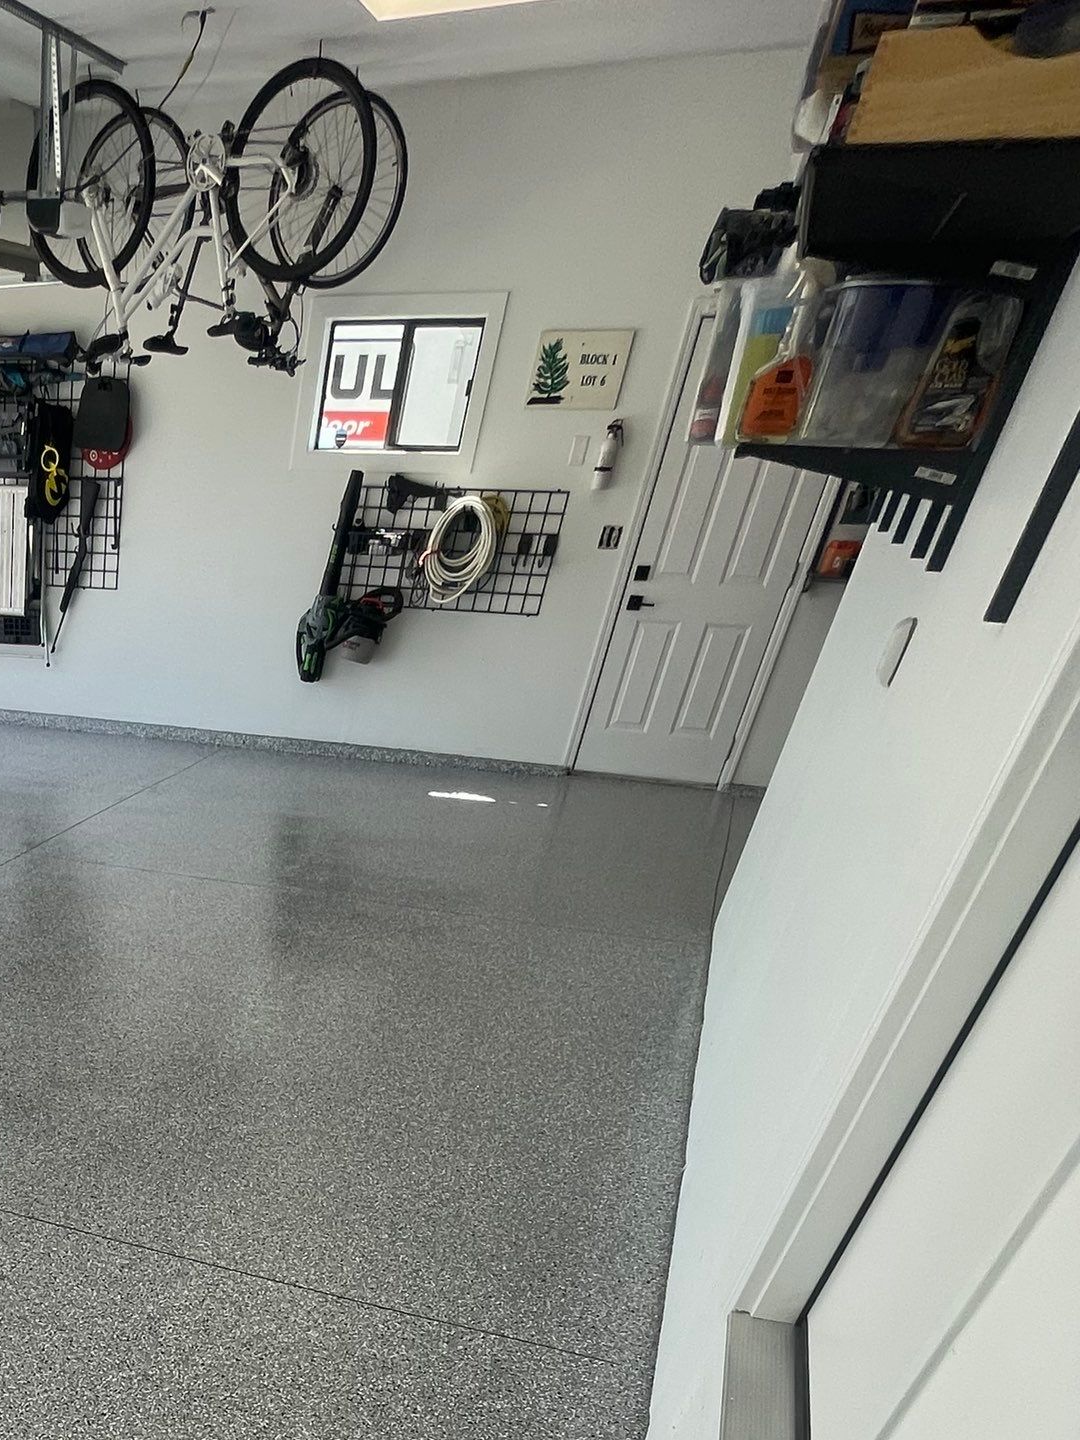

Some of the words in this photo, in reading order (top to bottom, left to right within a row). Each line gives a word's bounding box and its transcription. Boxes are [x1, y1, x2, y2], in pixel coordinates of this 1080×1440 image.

[580, 353, 610, 366] BLOCK
[611, 353, 618, 366] 1
[580, 375, 598, 387] LOT
[599, 374, 608, 387] 6
